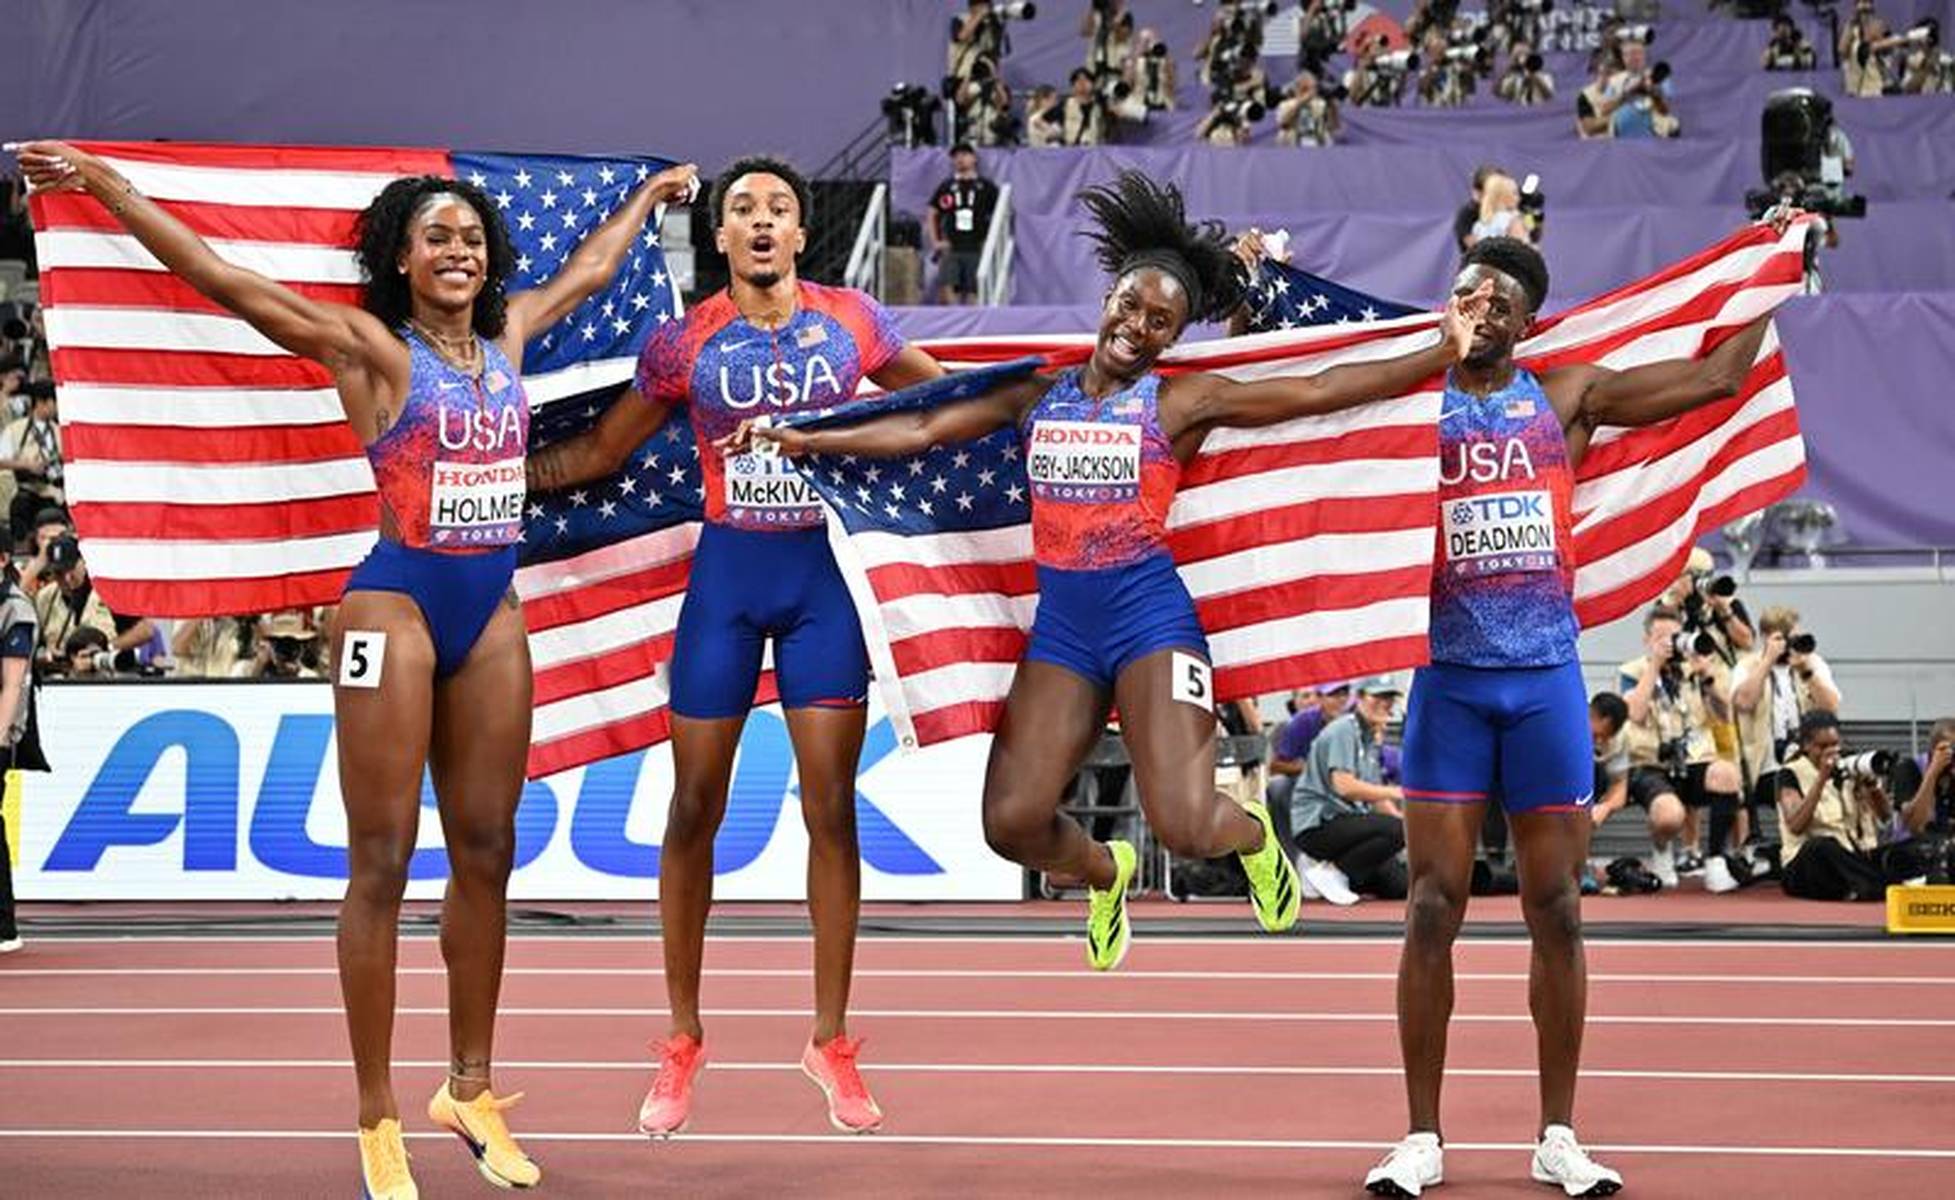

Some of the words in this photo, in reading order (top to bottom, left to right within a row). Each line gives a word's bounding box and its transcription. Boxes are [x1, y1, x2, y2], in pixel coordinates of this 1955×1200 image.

[720, 354, 842, 409] USA
[439, 404, 522, 450] USA
[1035, 428, 1136, 445] HONDA
[1440, 437, 1536, 485] USA
[1471, 495, 1544, 521] TDK
[1450, 524, 1552, 557] DEADMON
[349, 640, 369, 679] 5
[1187, 664, 1205, 698] 5
